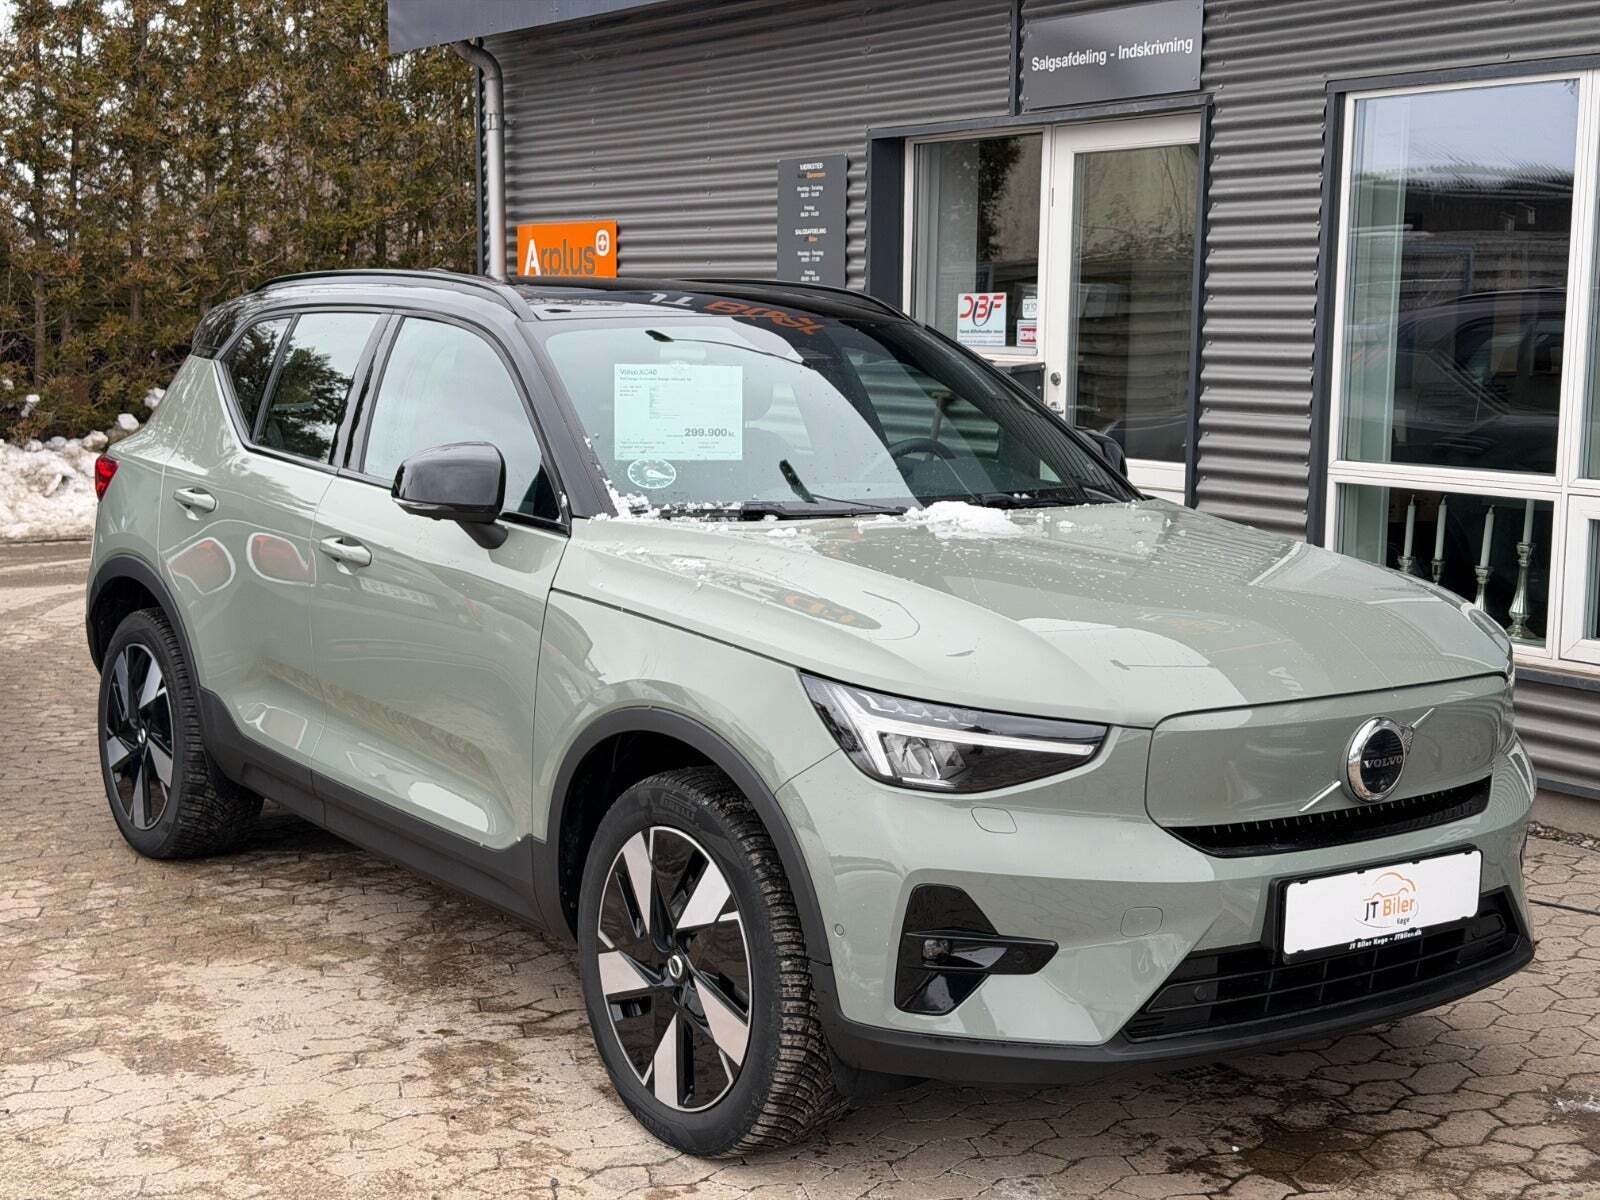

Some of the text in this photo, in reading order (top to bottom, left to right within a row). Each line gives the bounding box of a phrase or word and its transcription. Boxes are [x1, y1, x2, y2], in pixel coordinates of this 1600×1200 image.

[1031, 49, 1107, 72] Salgsafdeling
[1118, 37, 1193, 60] Indskrivning
[620, 368, 658, 376] Volvo XC40
[684, 428, 728, 438] 299.900
[1363, 755, 1403, 769] VOLVO
[1363, 895, 1416, 921] JT Biler
[1357, 940, 1372, 949] Biler
